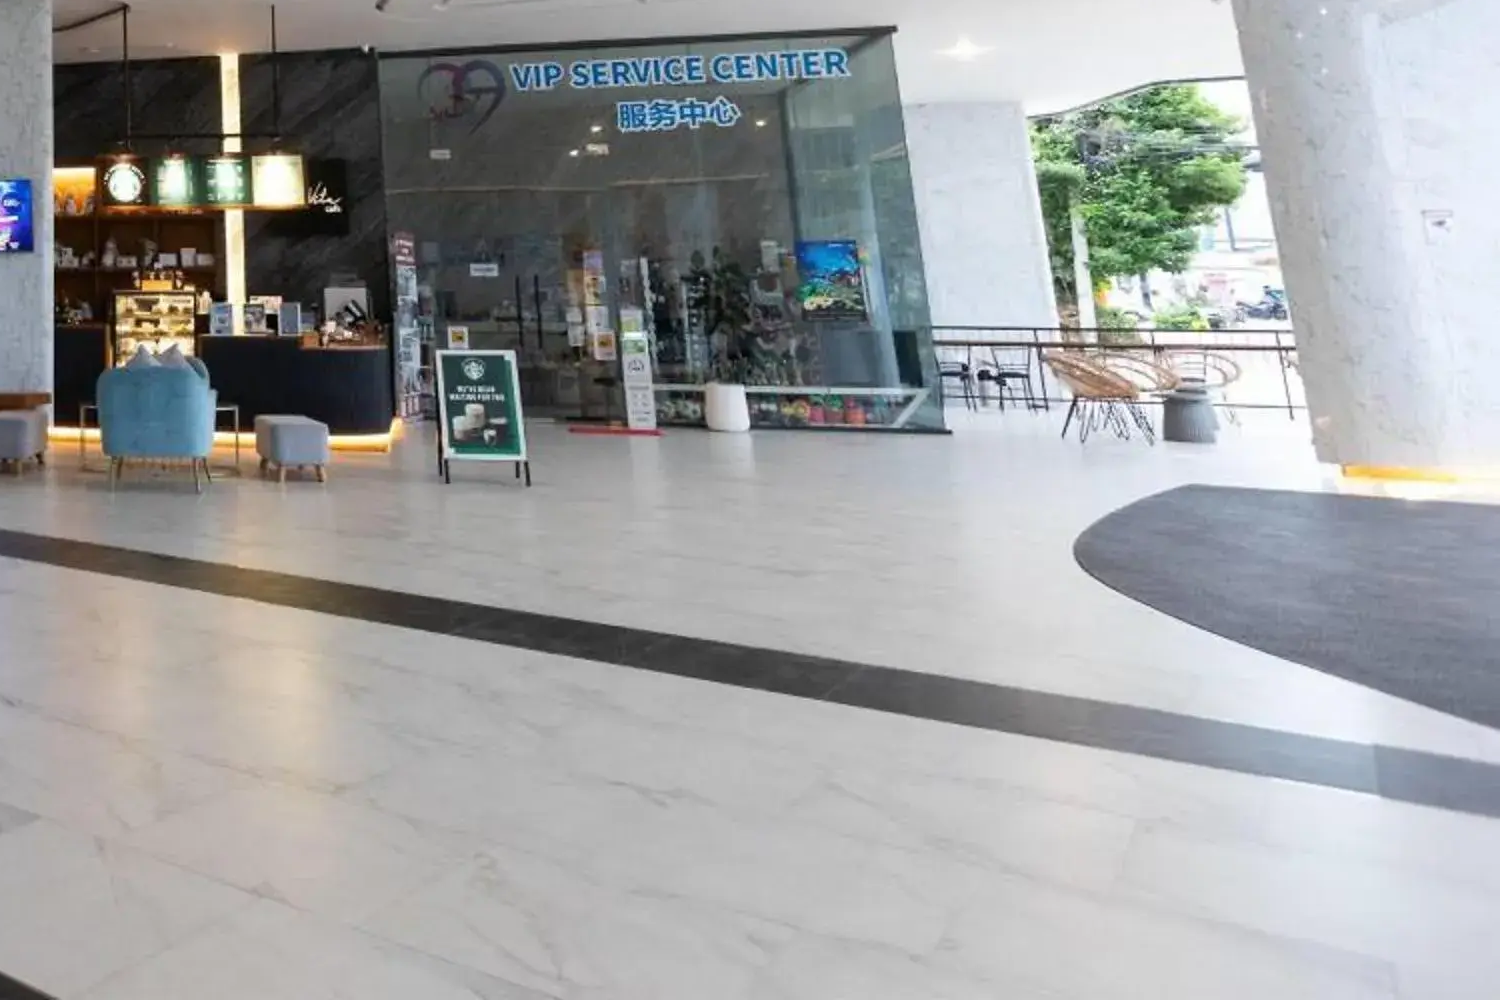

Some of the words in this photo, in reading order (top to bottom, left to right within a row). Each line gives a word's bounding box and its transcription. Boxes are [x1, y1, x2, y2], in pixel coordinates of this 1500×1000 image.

[510, 62, 562, 91] VIP
[570, 55, 704, 88] SERVICE
[712, 48, 850, 81] CENTER
[616, 96, 741, 132] 服务中心
